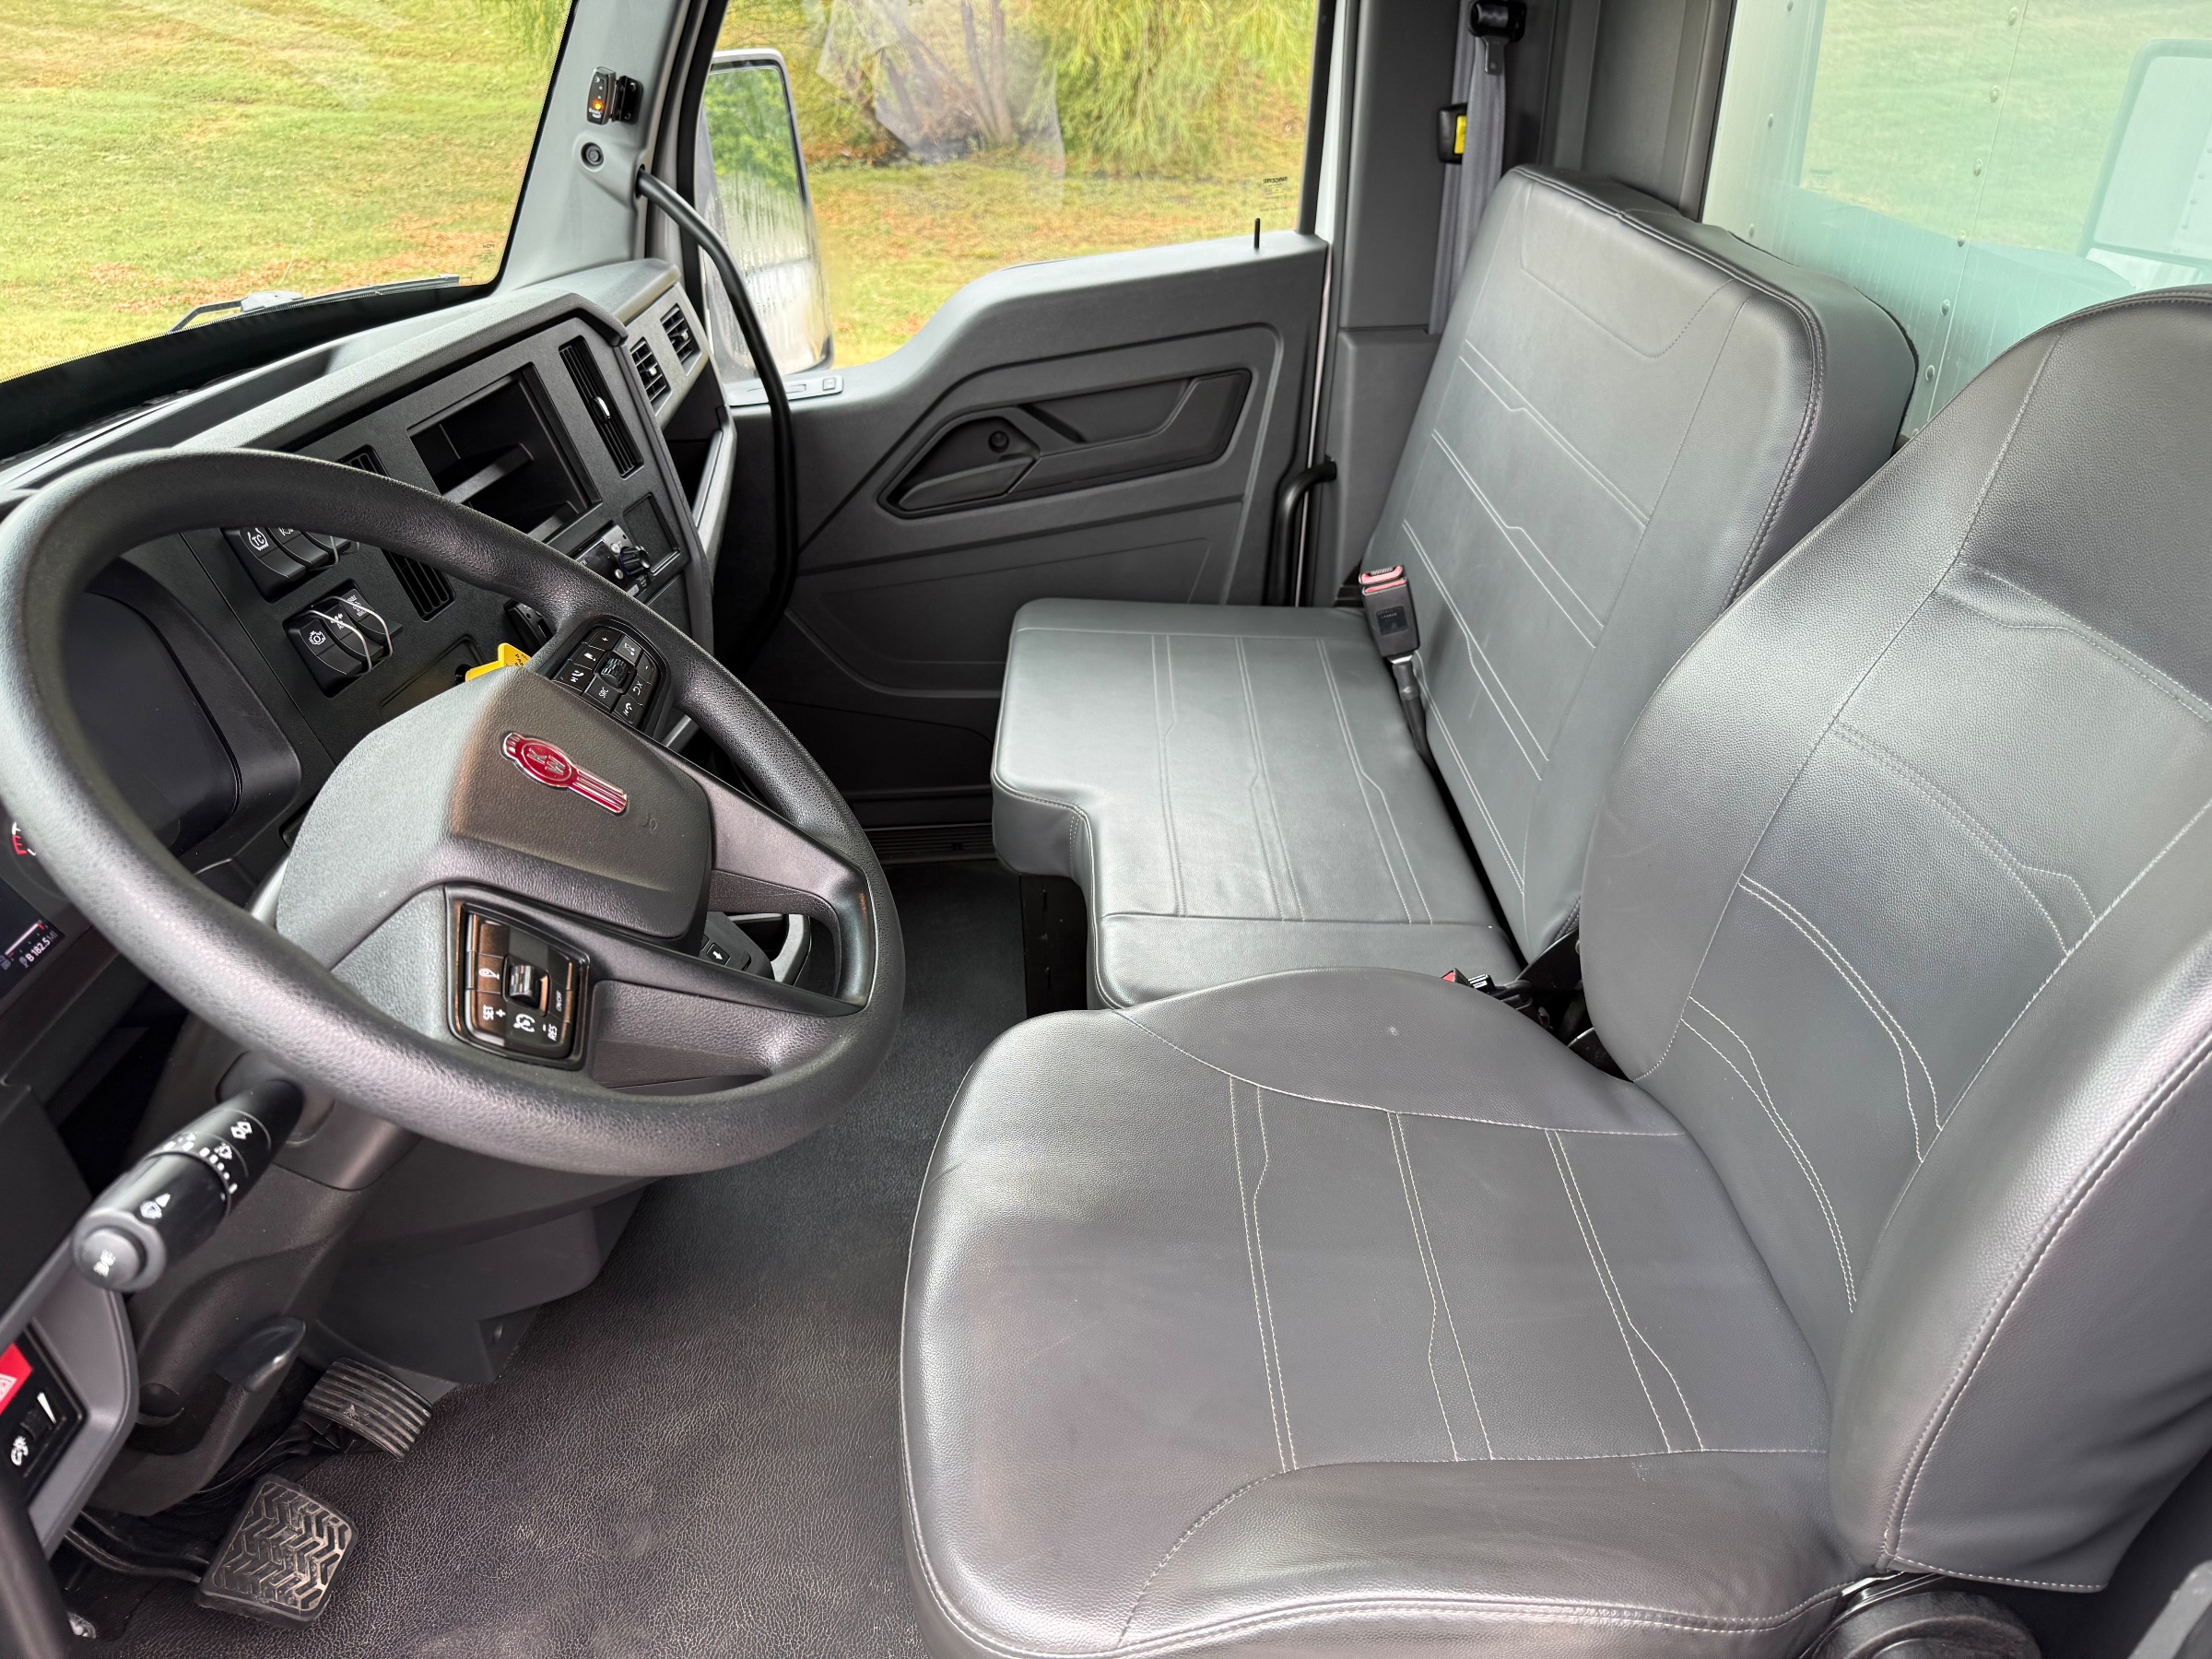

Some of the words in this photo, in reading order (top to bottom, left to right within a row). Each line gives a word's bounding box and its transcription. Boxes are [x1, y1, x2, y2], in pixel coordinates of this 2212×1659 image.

[252, 534, 265, 547] TC
[30, 936, 51, 957] 182.5
[482, 1004, 495, 1021] SET
[547, 1023, 558, 1041] RES
